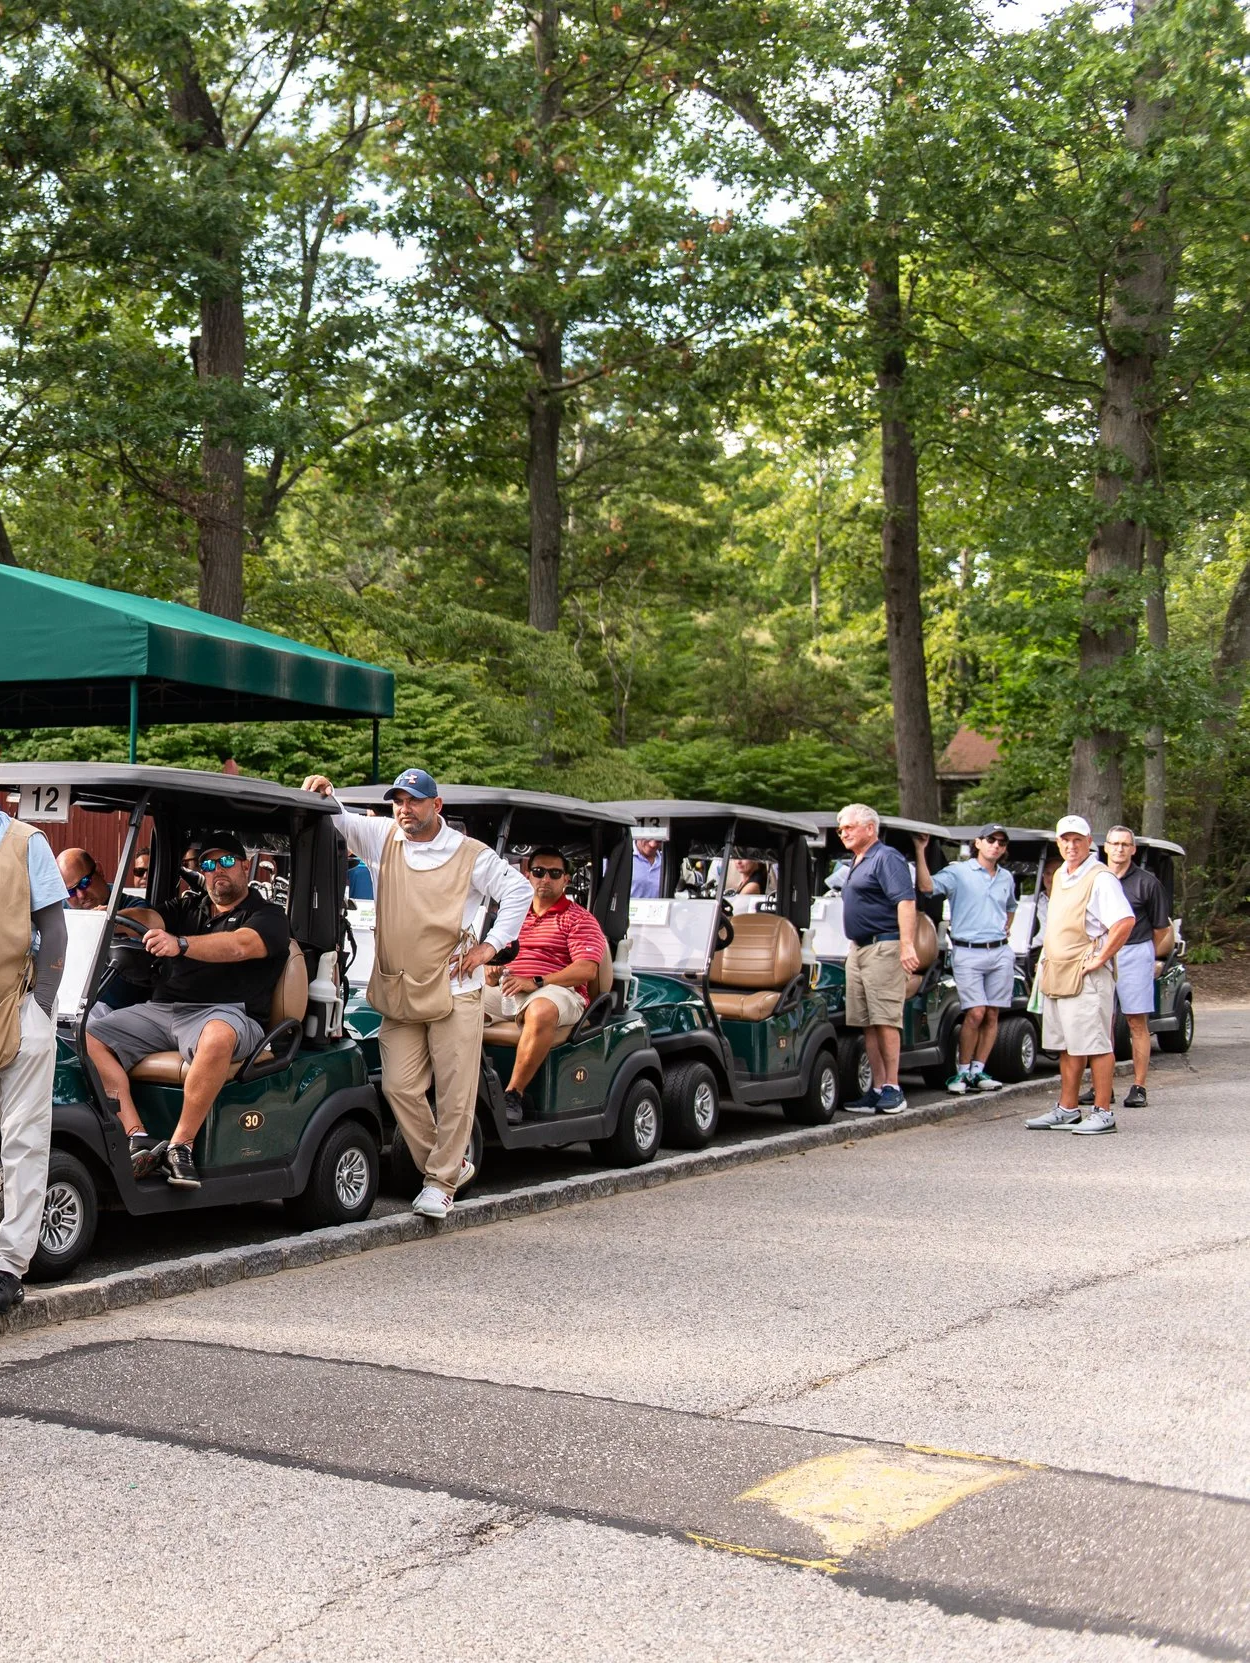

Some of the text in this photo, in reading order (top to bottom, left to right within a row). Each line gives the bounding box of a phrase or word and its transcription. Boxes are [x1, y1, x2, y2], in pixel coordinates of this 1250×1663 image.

[32, 786, 59, 812] 12
[575, 1070, 584, 1081] 41
[245, 1114, 259, 1127] 30
